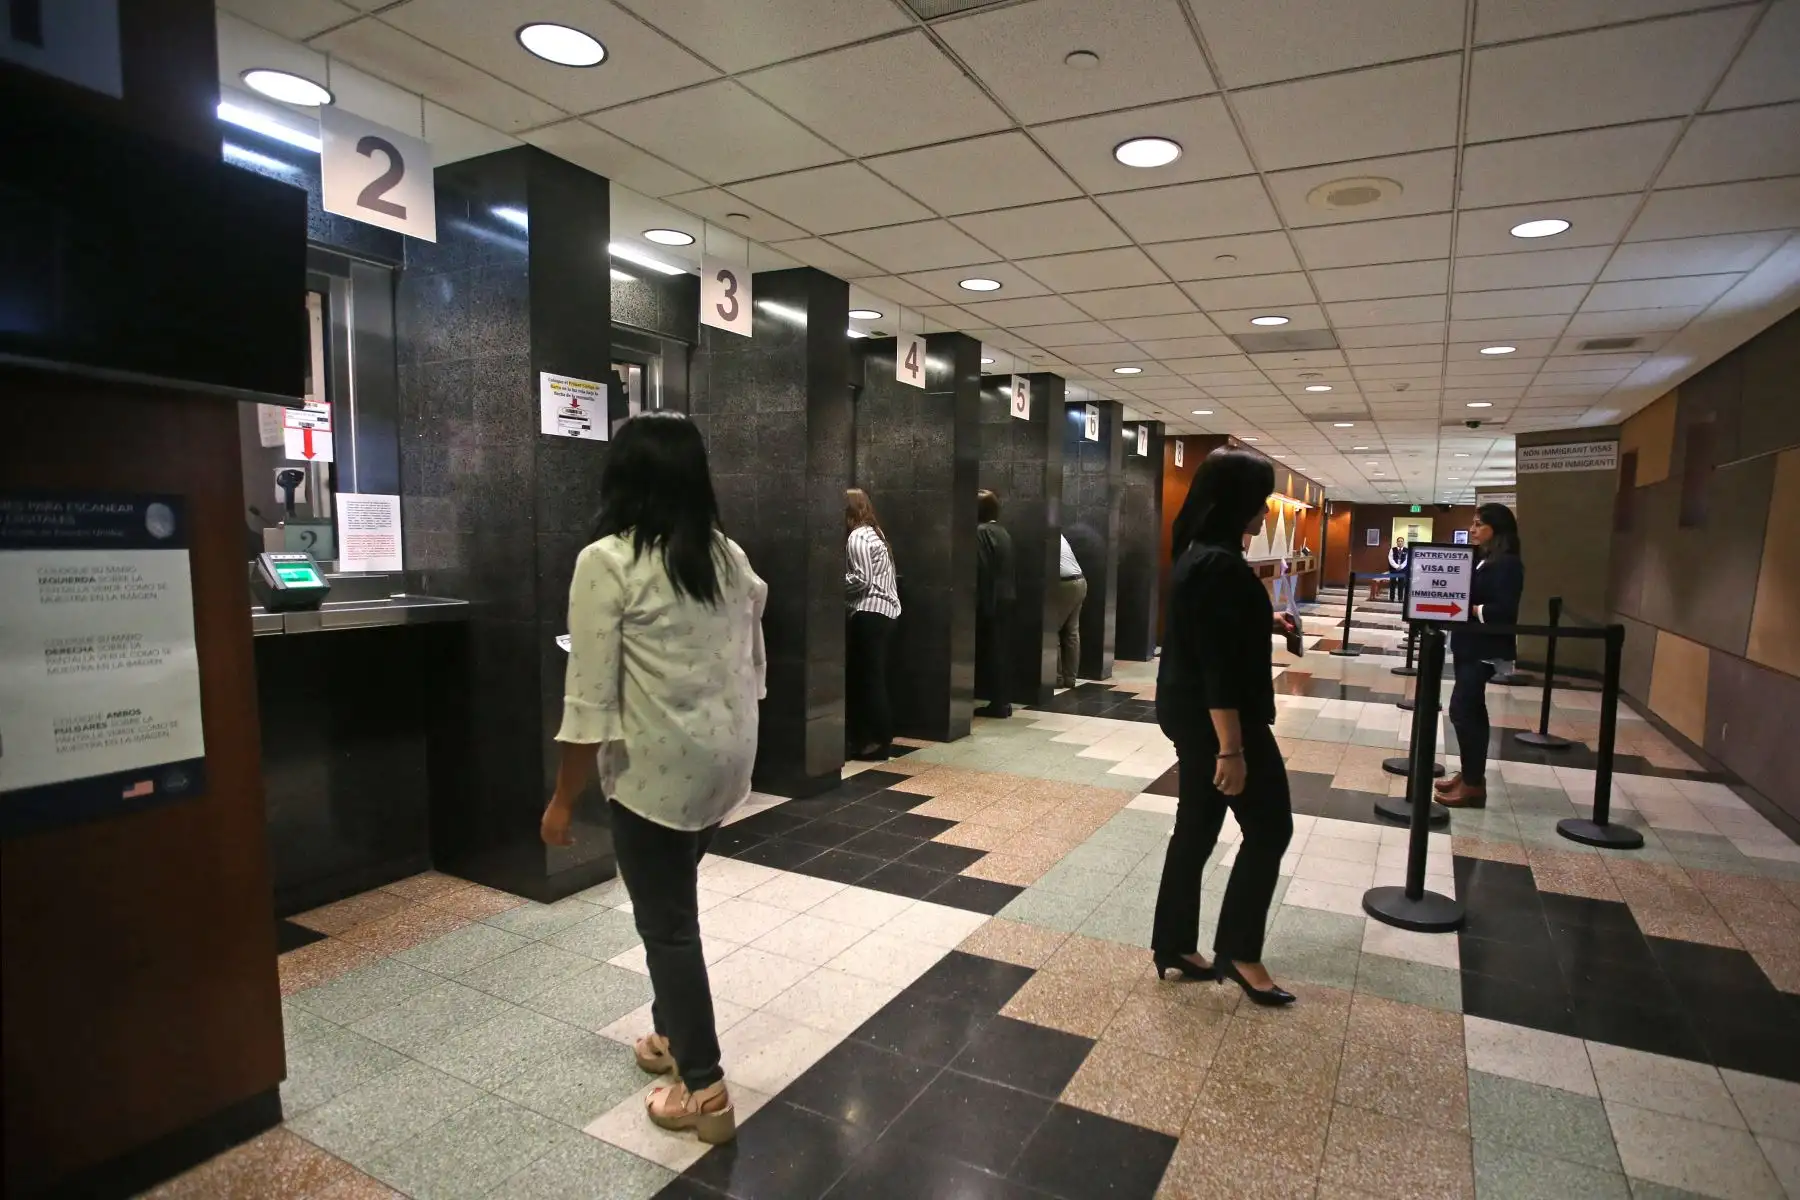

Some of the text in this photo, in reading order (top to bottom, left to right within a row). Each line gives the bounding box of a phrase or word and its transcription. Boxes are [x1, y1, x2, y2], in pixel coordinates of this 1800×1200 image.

[356, 135, 407, 220] 2
[716, 269, 739, 322] 3
[905, 341, 919, 379] 4
[1017, 382, 1025, 412] 5
[1090, 410, 1096, 436] 6
[1142, 430, 1146, 451] 7
[1523, 444, 1613, 457] NON IMMIGRANT VISAS
[1520, 462, 1539, 470] VISAS
[1565, 458, 1616, 468] INMIGRANTE
[66, 501, 134, 513] ESCANEAR
[300, 530, 317, 555] 2
[1415, 552, 1468, 560] ENTREVISTA
[1432, 579, 1447, 587] NO
[1412, 590, 1466, 599] INMIGRANTE
[44, 646, 94, 656] DERECHA
[106, 708, 142, 720] AMBOS
[54, 722, 108, 734] PULGARES
